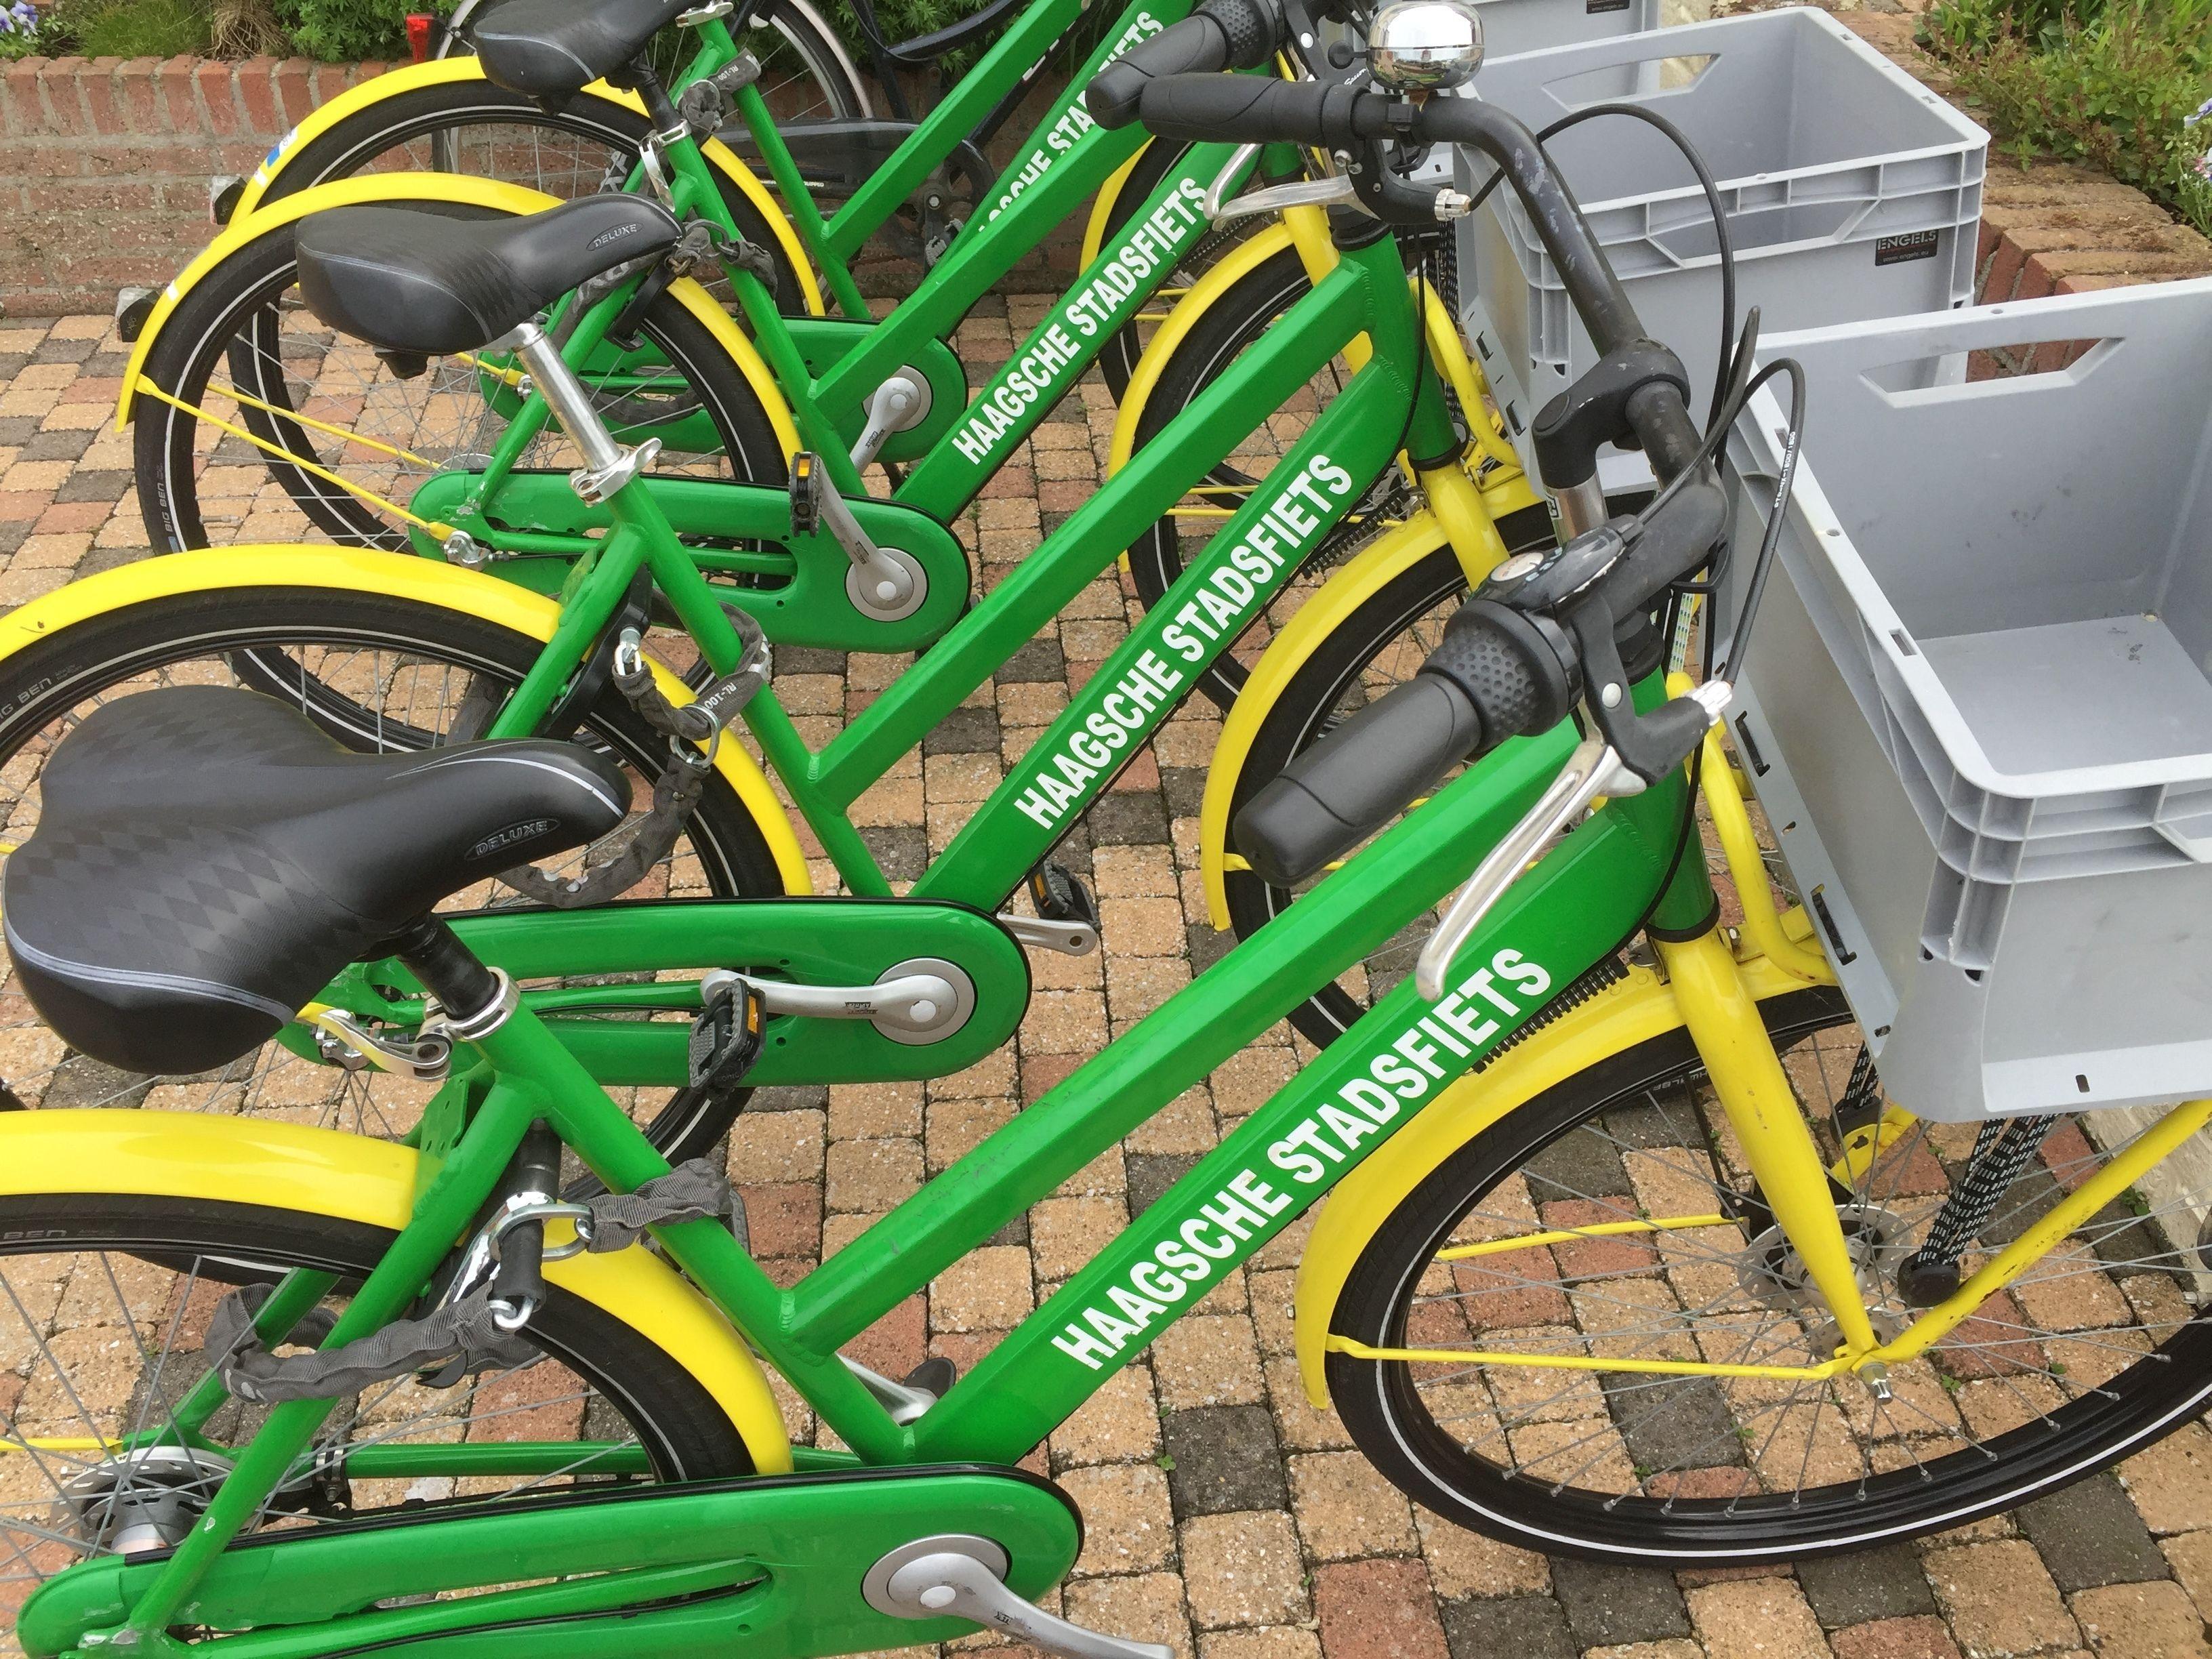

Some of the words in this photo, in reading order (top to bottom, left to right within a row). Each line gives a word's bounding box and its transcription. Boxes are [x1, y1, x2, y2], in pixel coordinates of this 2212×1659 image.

[593, 224, 637, 247] DELUXE
[1877, 231, 1936, 251] ENGELS
[951, 323, 1082, 466] HAAGSCHE
[1065, 178, 1207, 337] STADSFIETS
[162, 511, 173, 533] BIG
[1013, 649, 1184, 830] HAAGSCHE
[1162, 454, 1353, 663] STADSFIETS
[704, 682, 737, 710] RL-100
[475, 820, 548, 857] DELUXE
[1050, 1168, 1294, 1371] HAAGSCHE
[1266, 948, 1551, 1185] STADSFIETS
